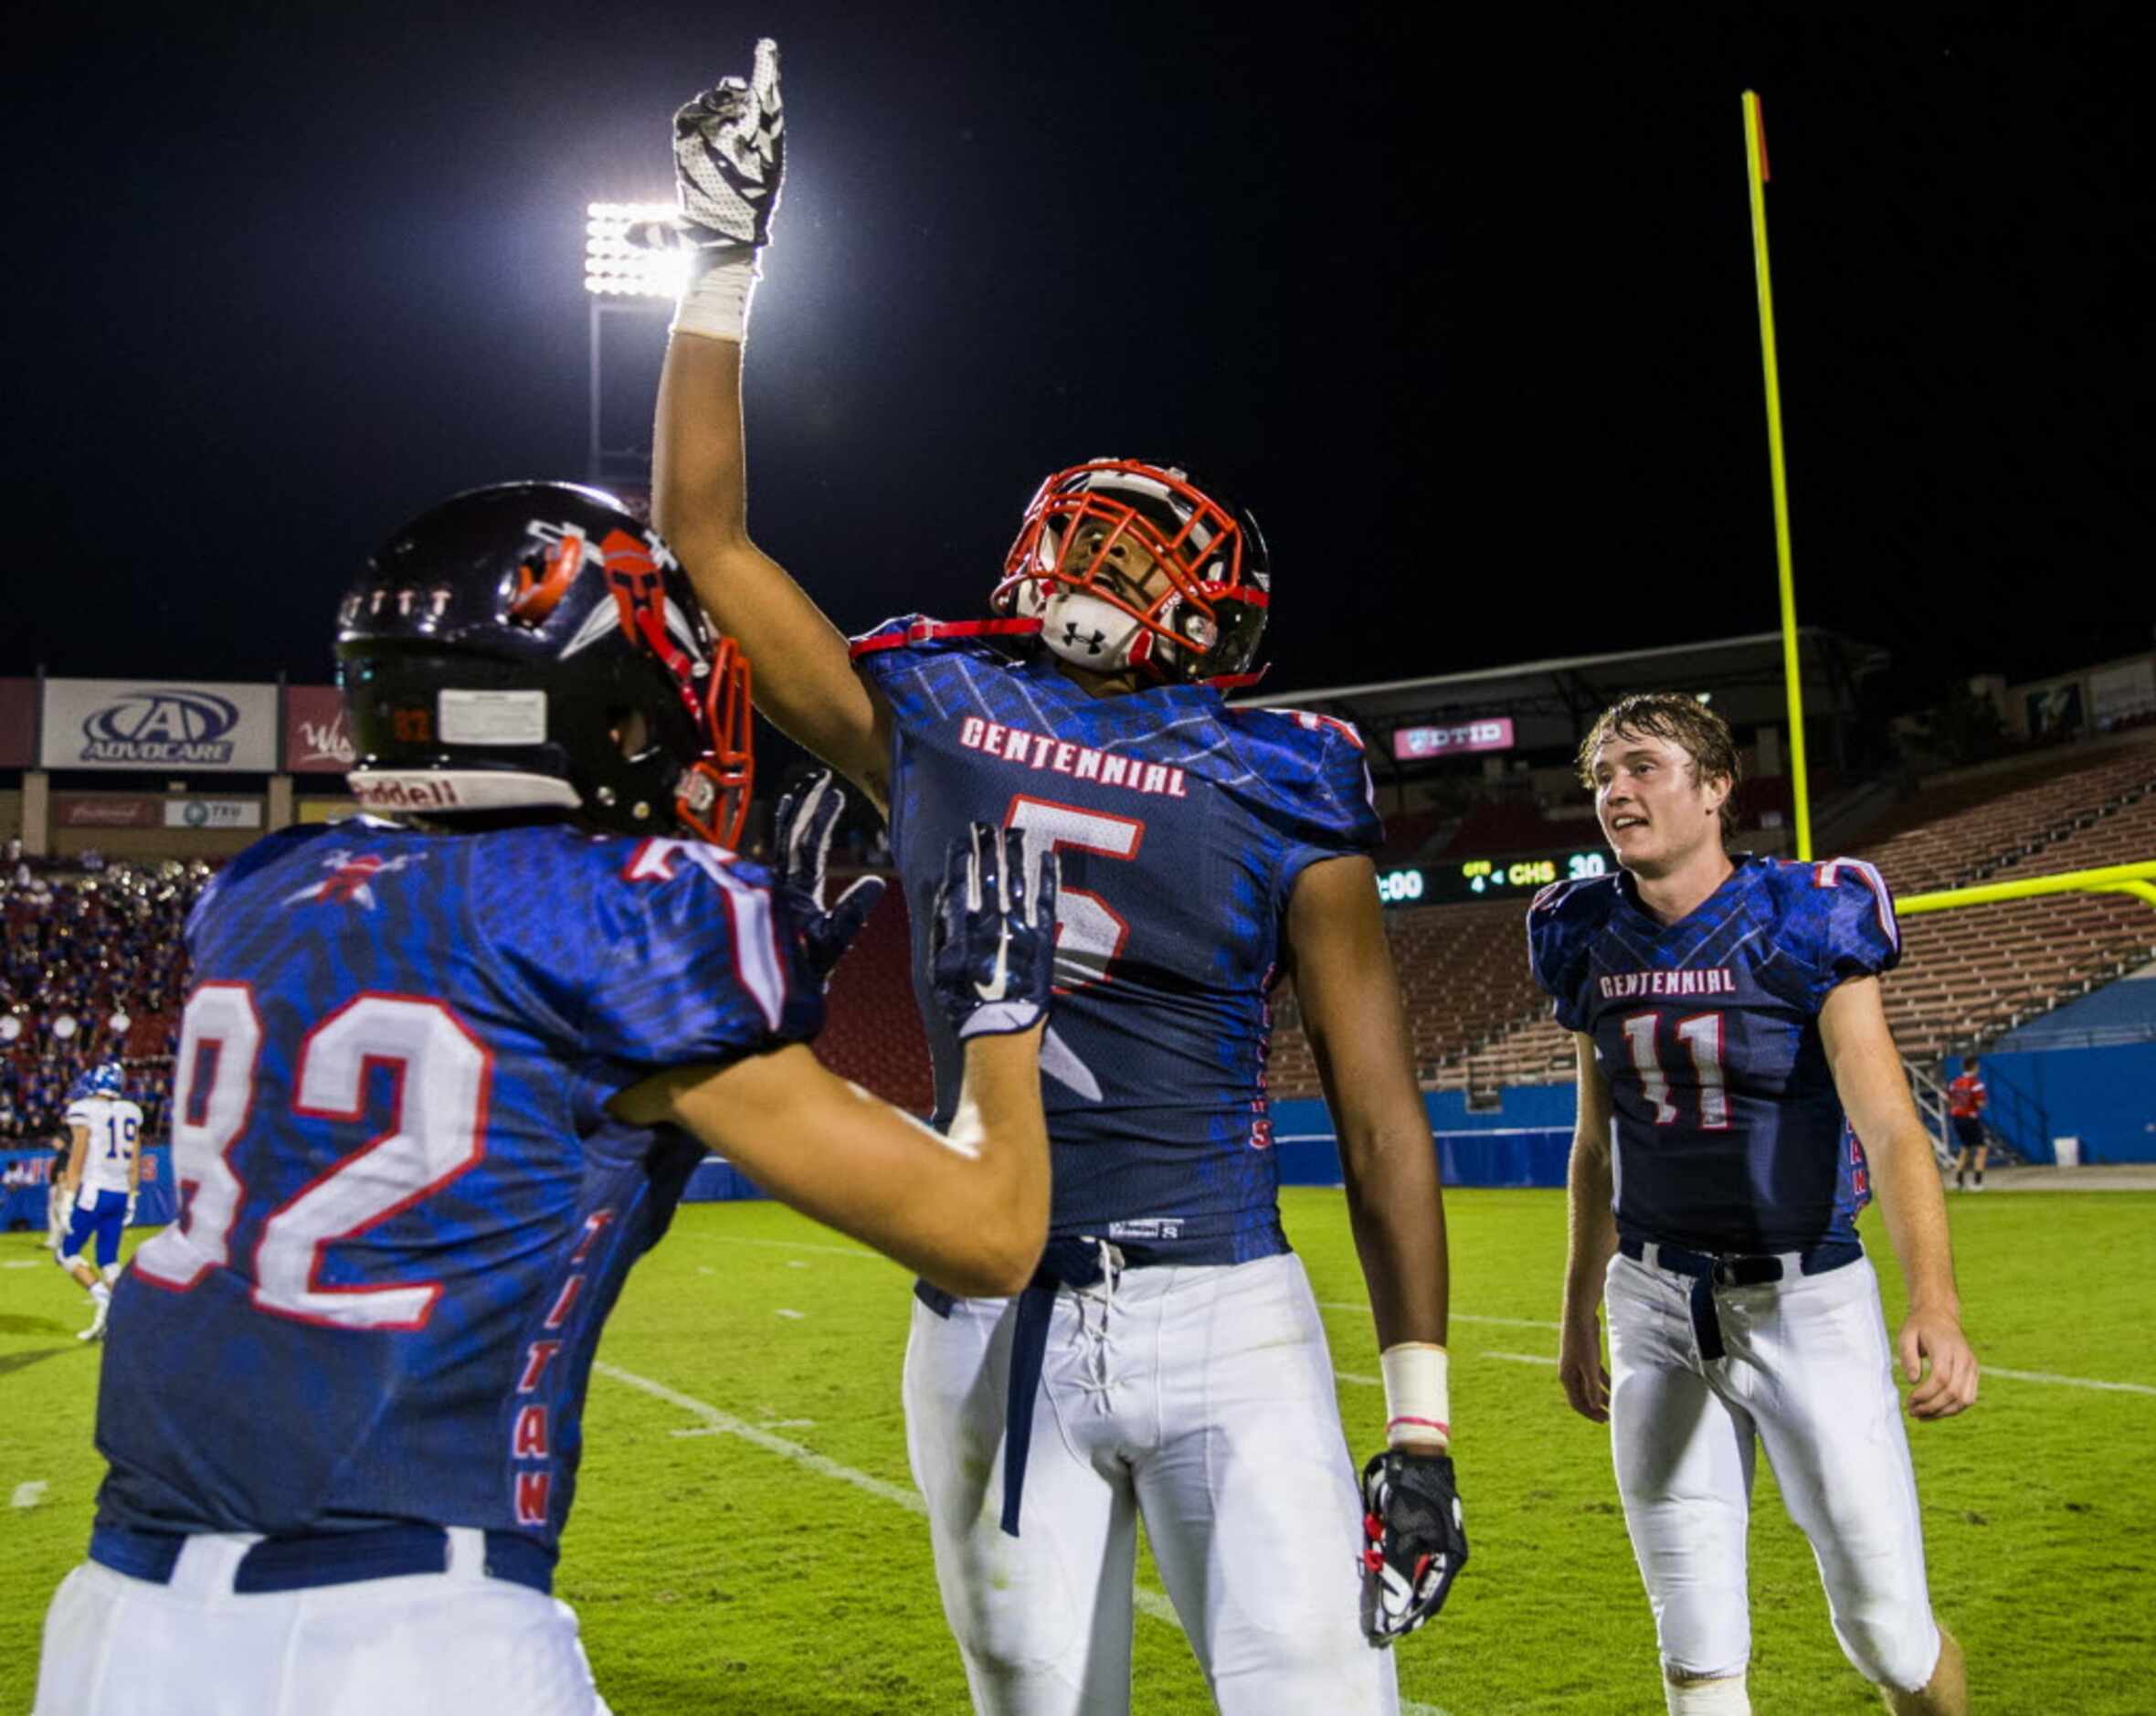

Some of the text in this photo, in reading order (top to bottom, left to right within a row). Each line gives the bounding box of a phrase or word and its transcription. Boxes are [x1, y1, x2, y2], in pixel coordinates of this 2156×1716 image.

[82, 741, 233, 763] ADVOCARE
[959, 715, 1187, 799] CENTENNIAL
[1509, 861, 1555, 885] CHS
[1569, 853, 1605, 879] 30
[1005, 791, 1145, 994] 5
[1377, 869, 1423, 902] :00
[1598, 967, 1736, 999] CENTENNIAL
[1622, 1009, 1733, 1130] 11
[105, 1116, 137, 1160] 19
[132, 980, 494, 1330] 82
